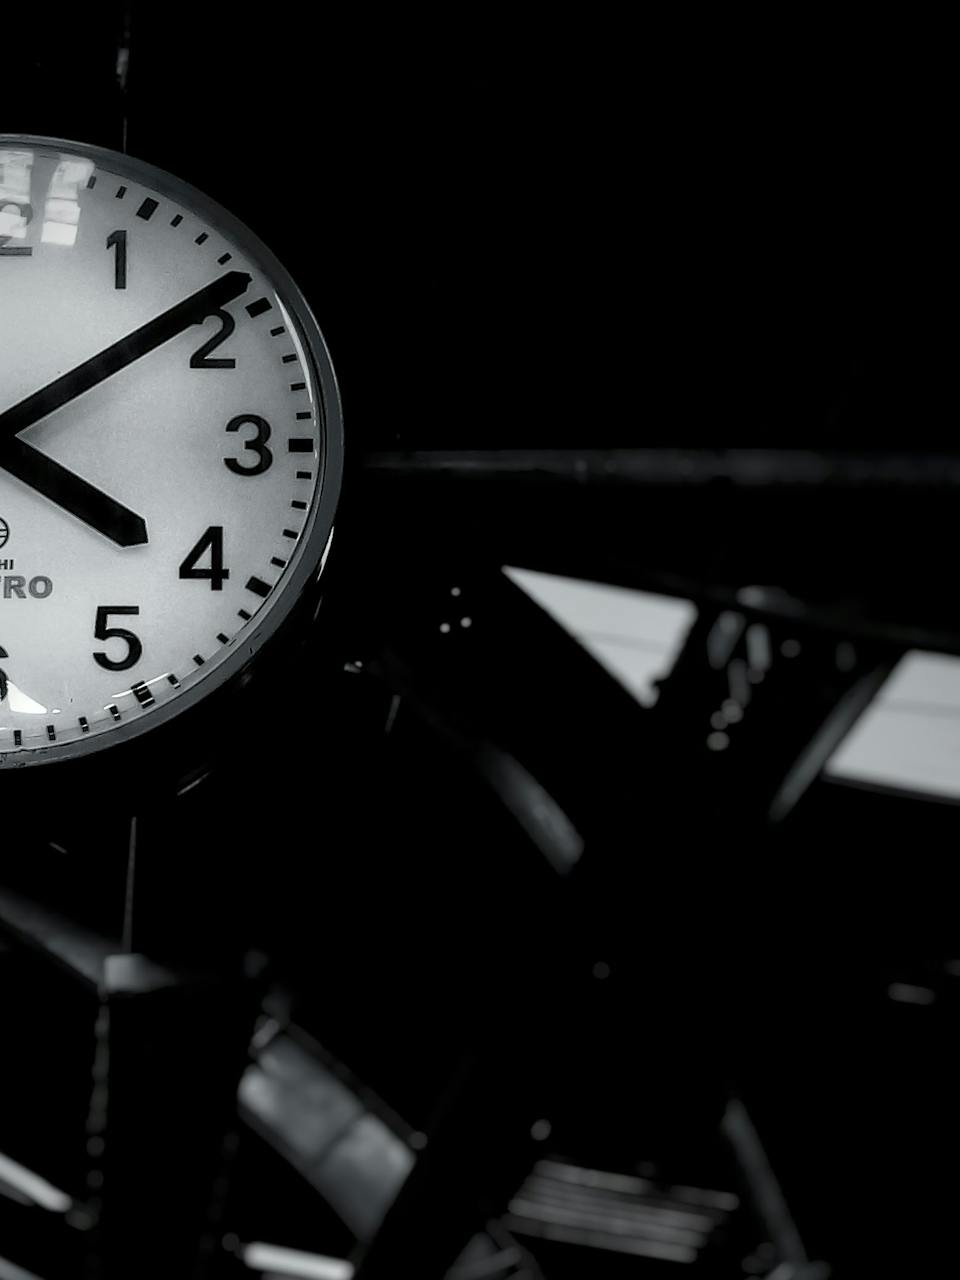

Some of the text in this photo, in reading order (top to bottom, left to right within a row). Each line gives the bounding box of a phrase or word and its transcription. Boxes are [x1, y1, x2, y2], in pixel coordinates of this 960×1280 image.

[106, 229, 126, 290] 1
[189, 308, 236, 369] 2
[223, 415, 273, 476] 3
[179, 526, 230, 591] 4
[93, 606, 143, 671] 5
